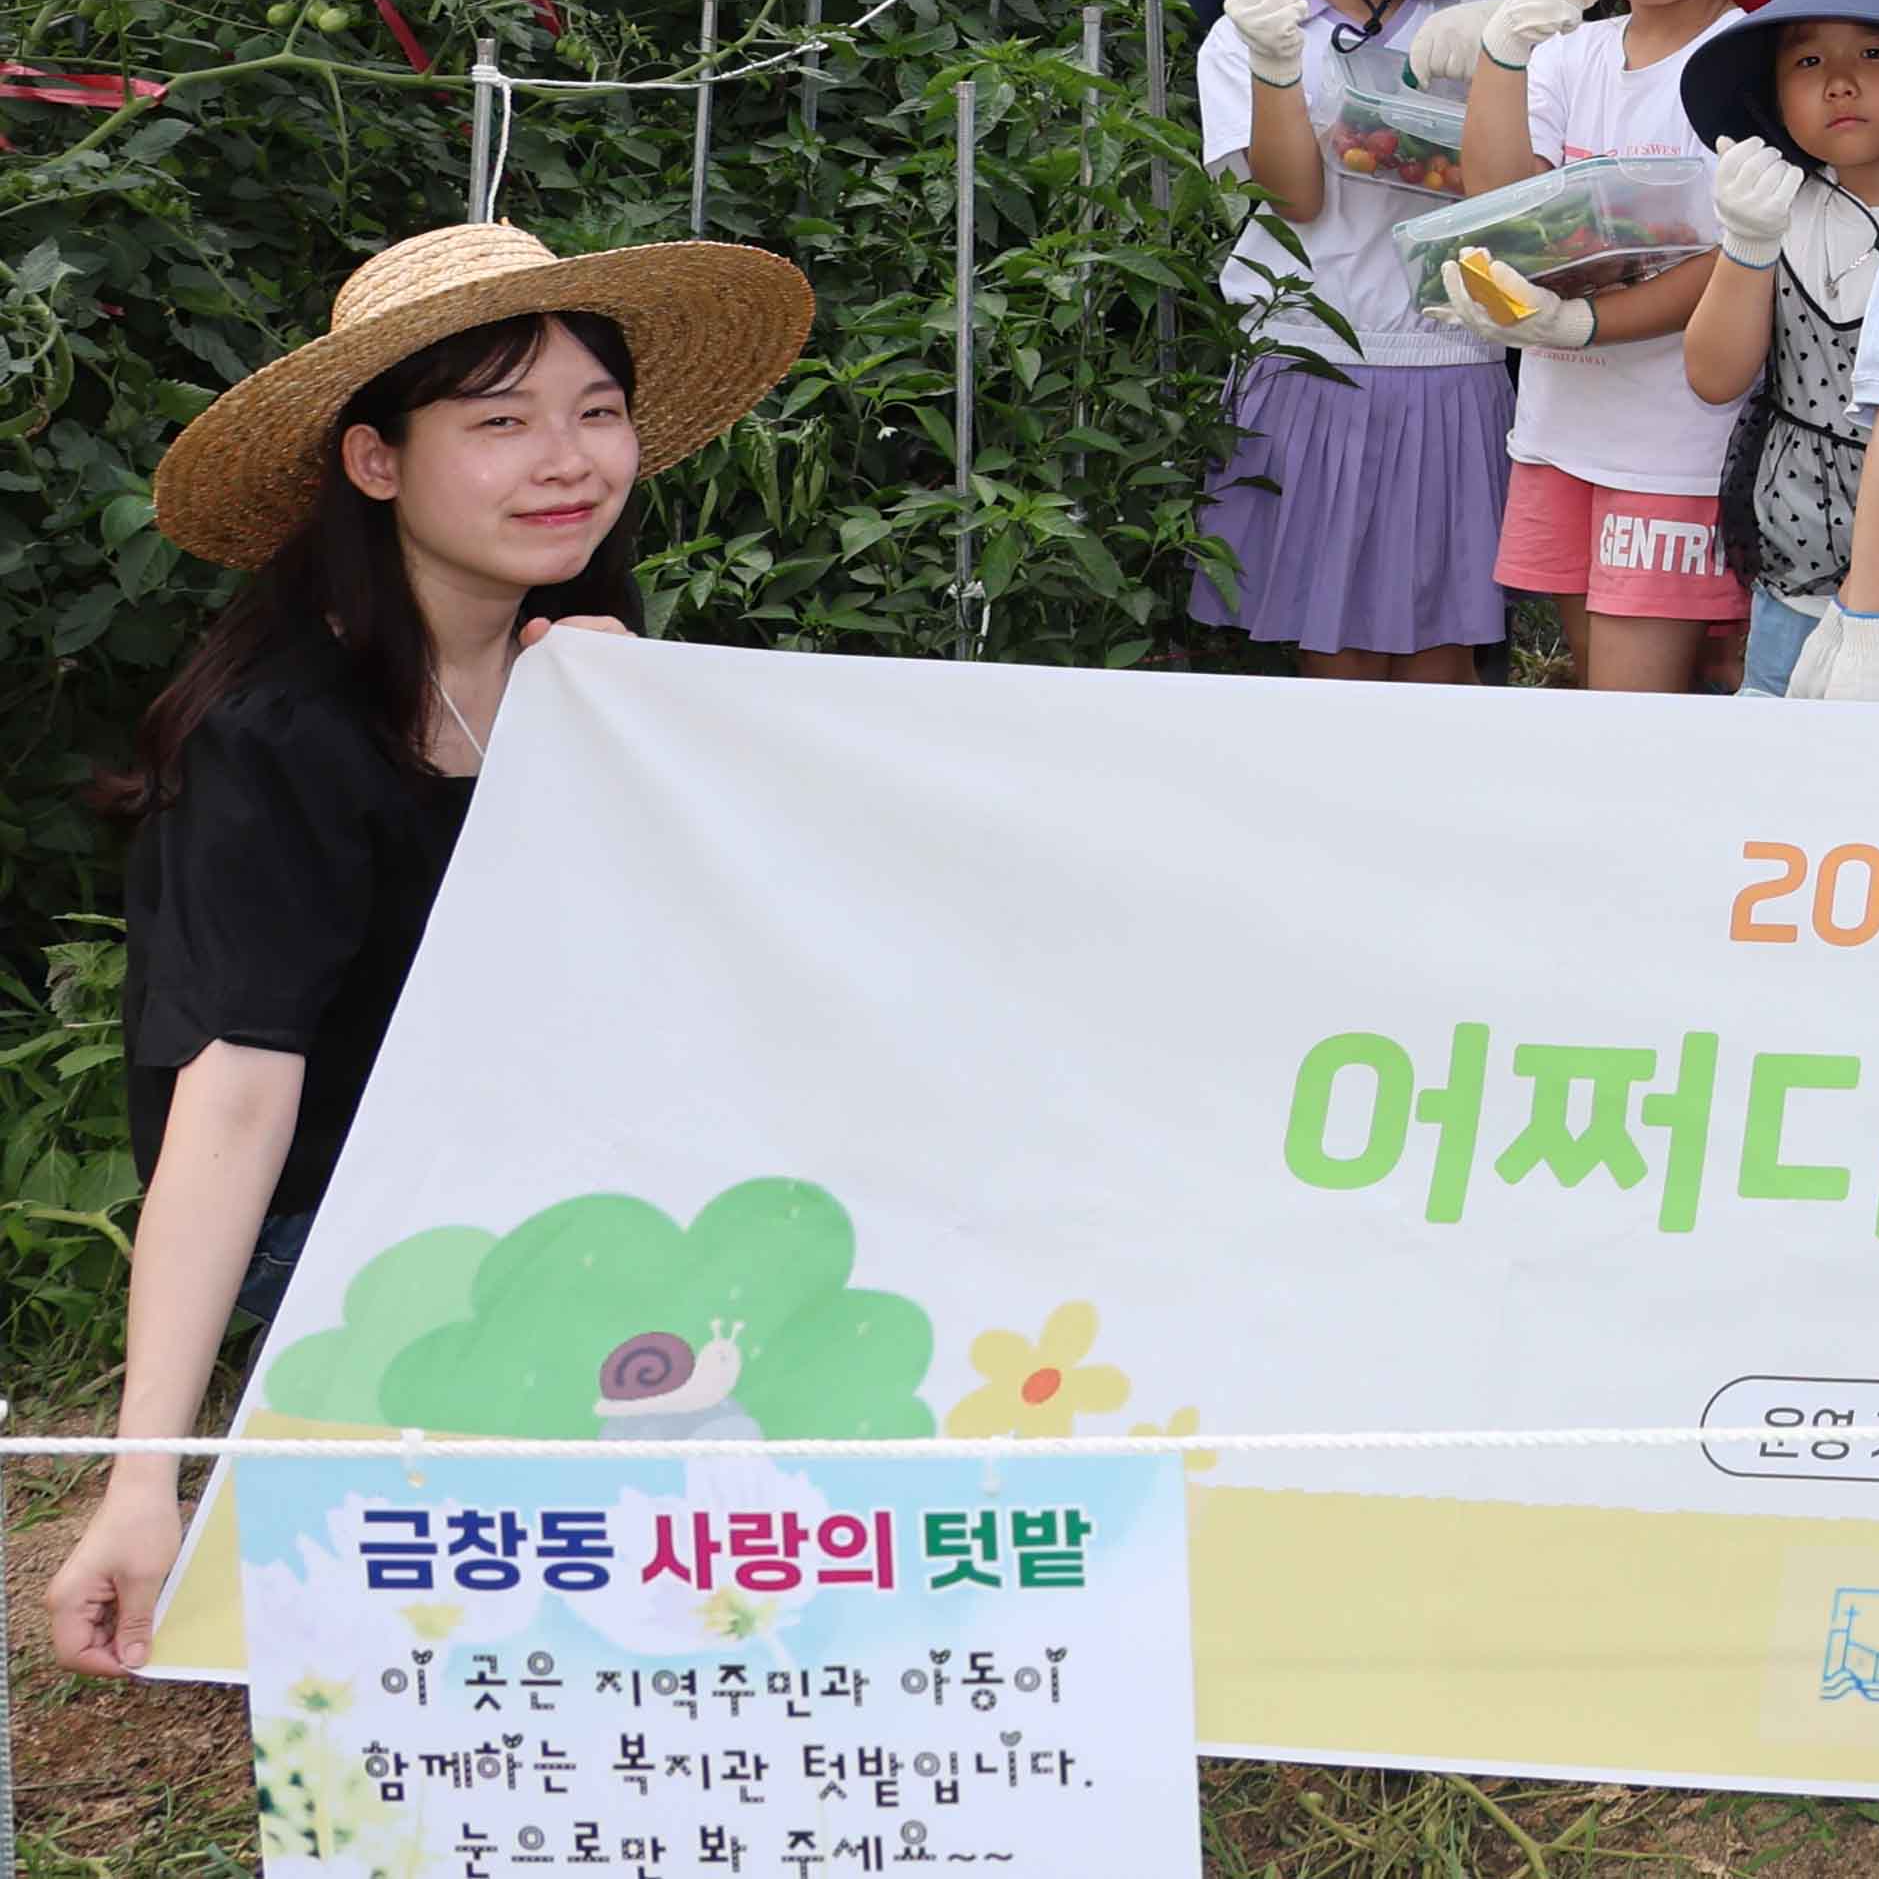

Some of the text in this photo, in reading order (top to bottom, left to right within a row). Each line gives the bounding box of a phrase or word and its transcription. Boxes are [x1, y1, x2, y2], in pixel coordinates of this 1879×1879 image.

[358, 1509, 1092, 1591] 금창동 사랑의 텃밭
[380, 1646, 1069, 1720] 이 곳은 지역주민과 아동이
[363, 1729, 1094, 1808] 함께하는 복지관 텃밭입니다.
[454, 1819, 1014, 1879] 눈으로만 봐 주세요~~
